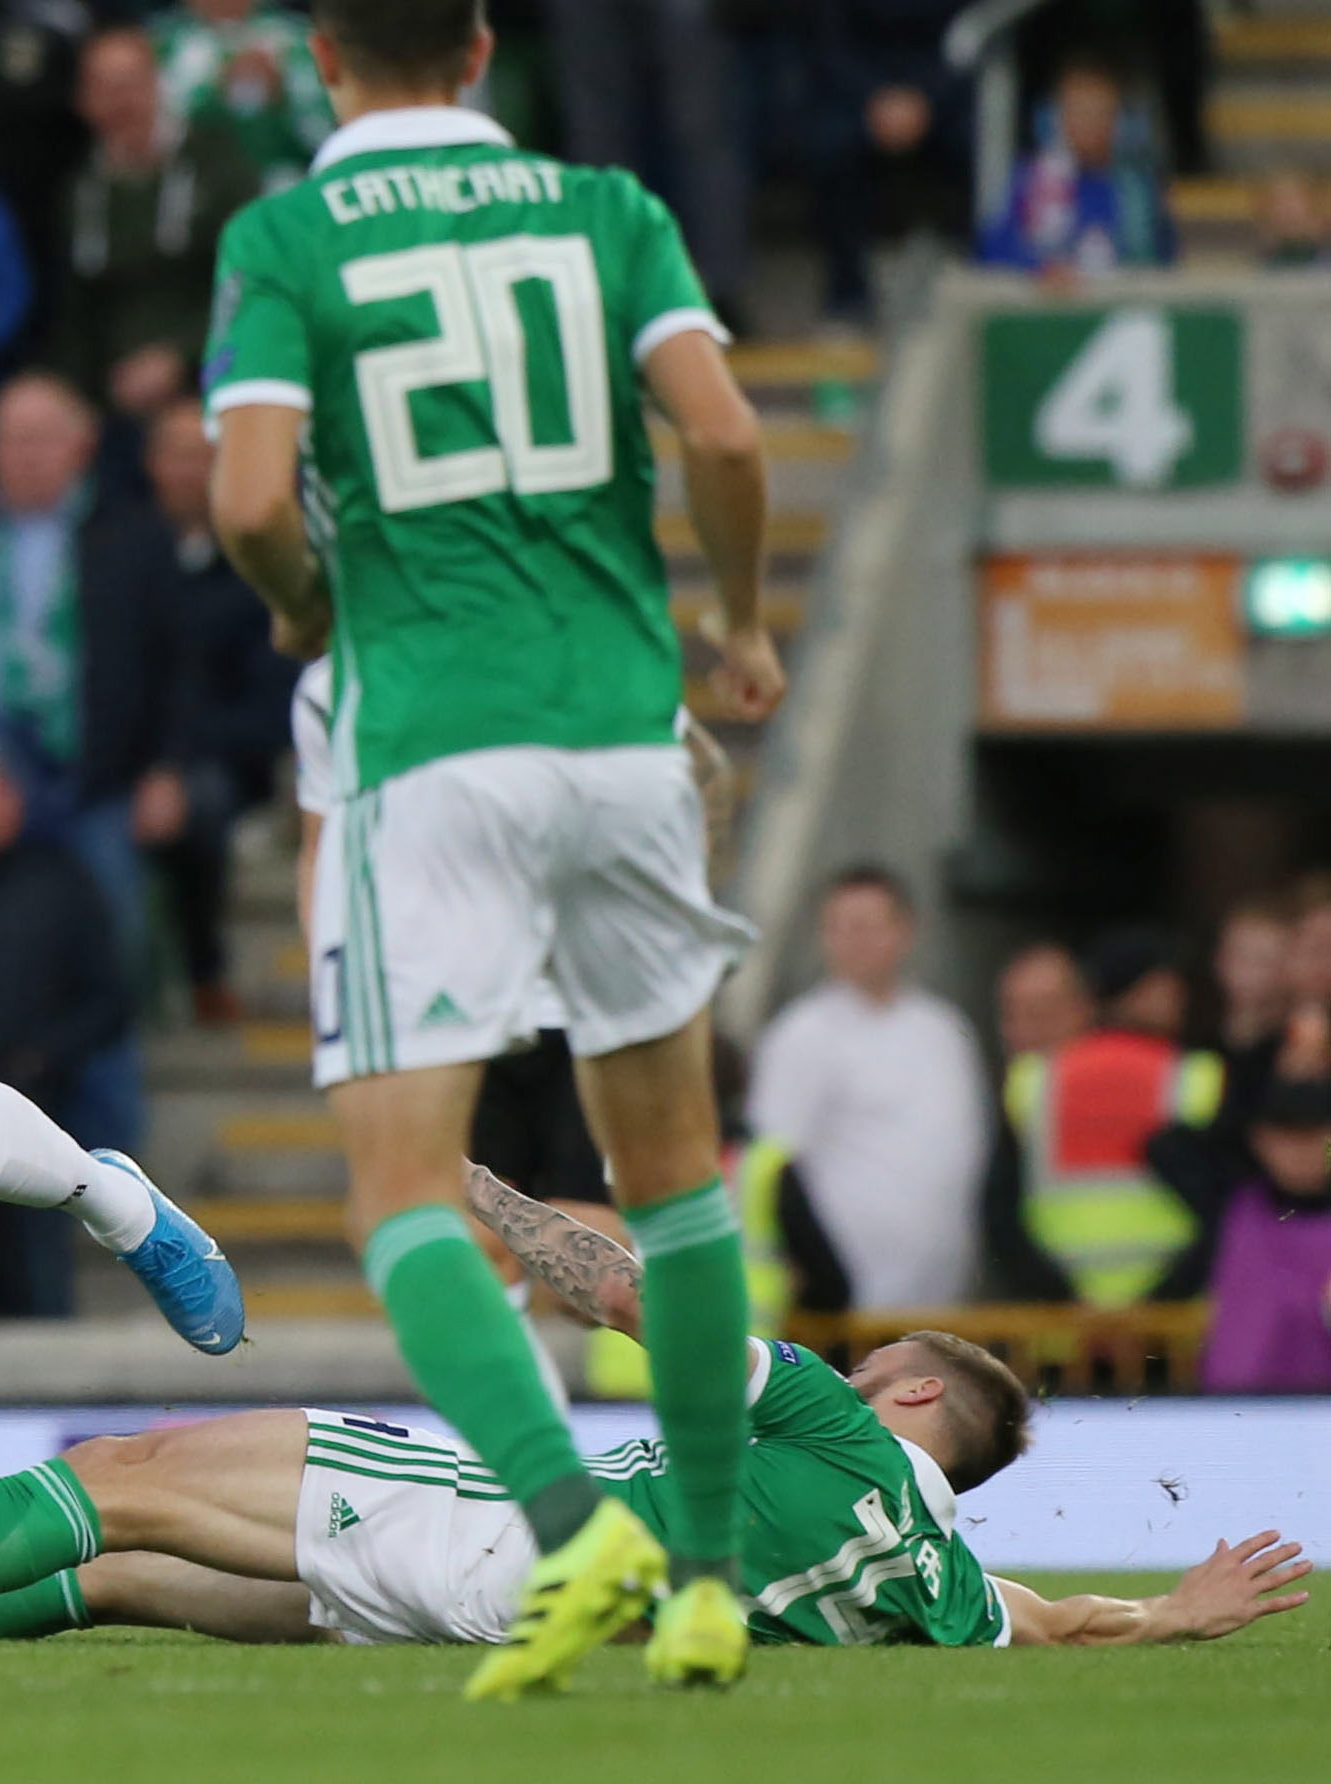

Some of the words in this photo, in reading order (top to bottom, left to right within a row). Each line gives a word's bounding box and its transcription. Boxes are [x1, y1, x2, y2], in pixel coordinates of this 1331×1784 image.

[340, 233, 614, 513] 20
[1033, 309, 1195, 487] 4
[329, 1491, 341, 1538] adidas
